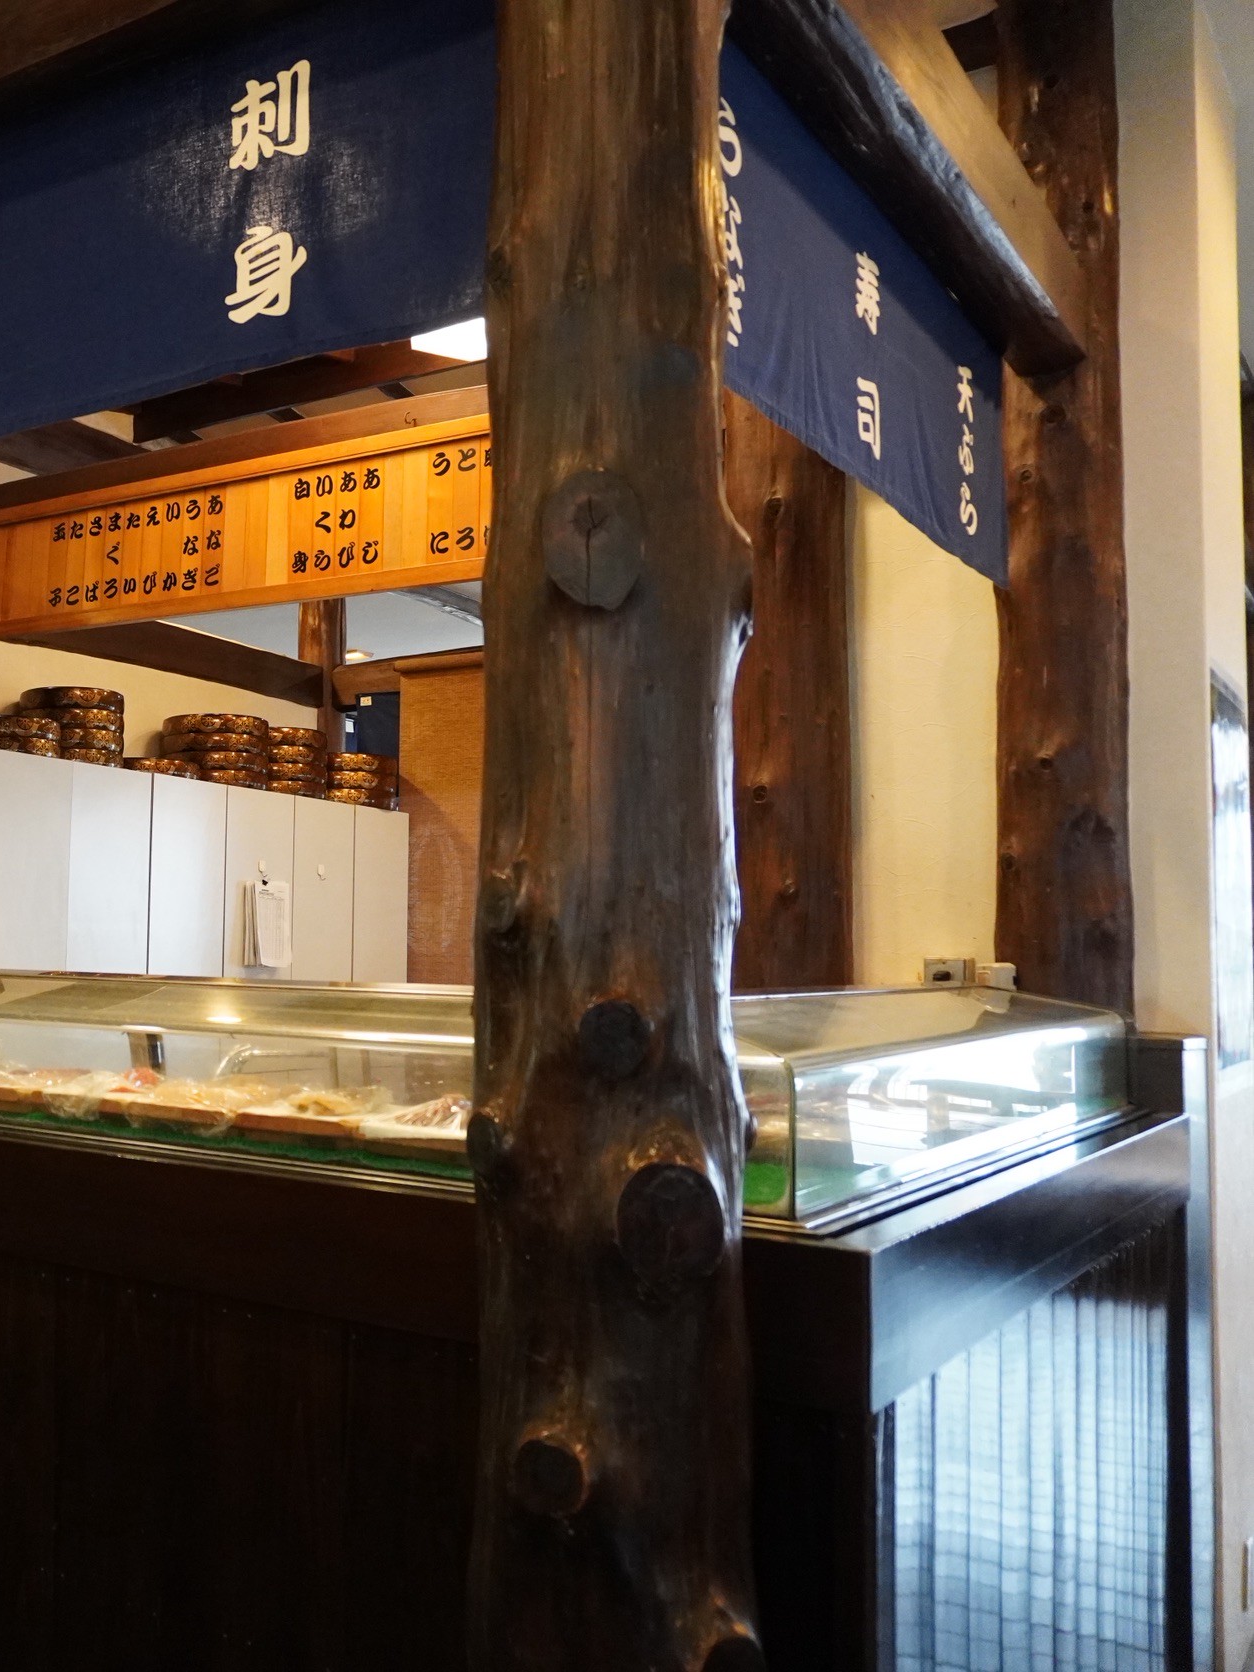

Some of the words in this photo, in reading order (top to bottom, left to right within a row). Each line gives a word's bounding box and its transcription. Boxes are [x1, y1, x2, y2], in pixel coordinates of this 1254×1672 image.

[224, 58, 311, 324] 刺身
[855, 251, 882, 461] 寿司
[455, 447, 477, 551] とろ
[957, 366, 978, 536] 天ぷら
[142, 506, 161, 595] えび
[162, 501, 181, 592] いか
[181, 499, 202, 591] うなぎ
[204, 494, 224, 587] あなご
[291, 478, 311, 574] 白身
[314, 474, 334, 571] いくら
[337, 470, 358, 569] あわび
[361, 467, 381, 565] あじ
[429, 452, 451, 555] うに
[65, 521, 84, 606] たこ
[103, 511, 122, 599] まぐろ
[123, 512, 141, 595] たい
